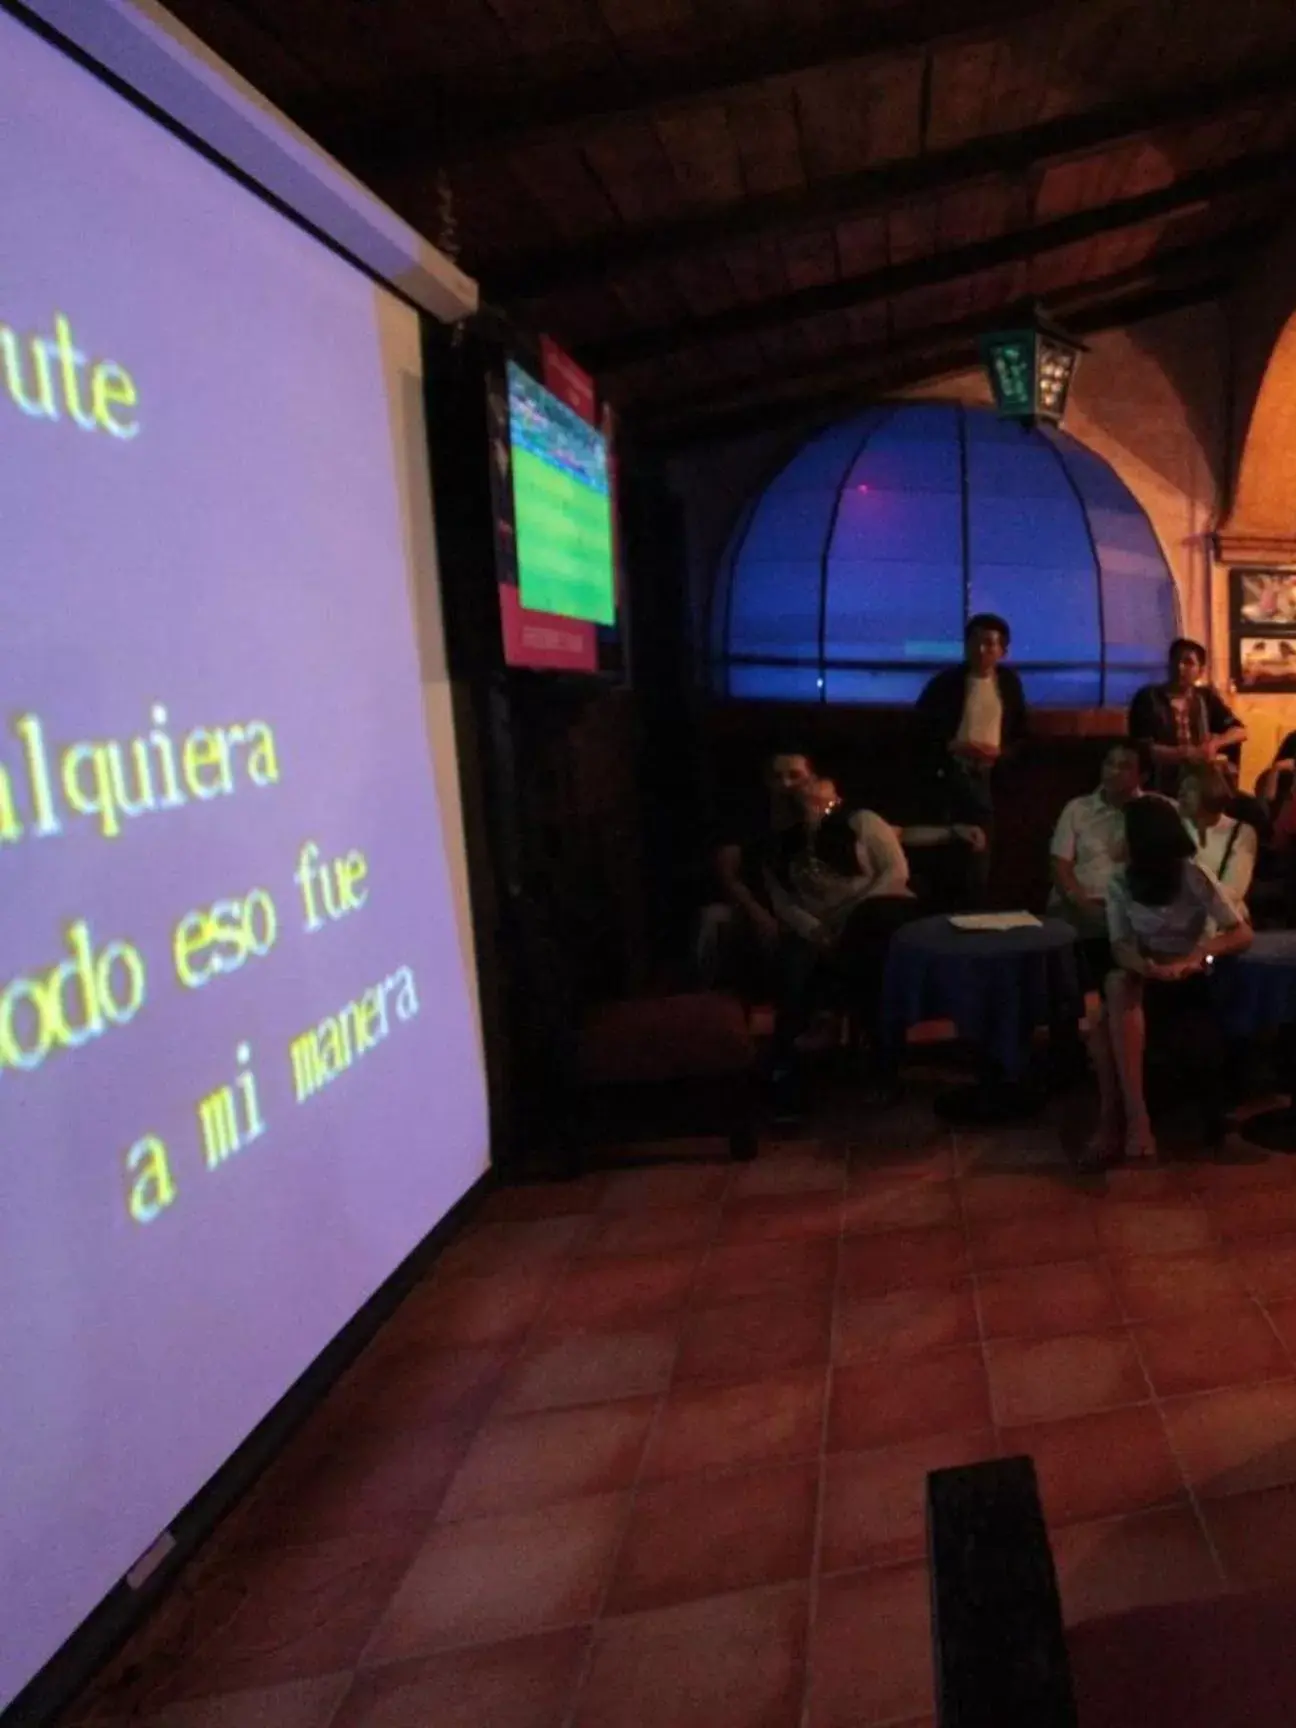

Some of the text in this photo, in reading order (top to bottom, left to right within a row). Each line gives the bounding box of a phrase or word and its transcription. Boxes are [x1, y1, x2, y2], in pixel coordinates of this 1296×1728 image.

[0, 311, 141, 440] ute
[174, 888, 277, 987] eso
[294, 841, 368, 933] fue
[126, 965, 419, 1224] a mi manera
